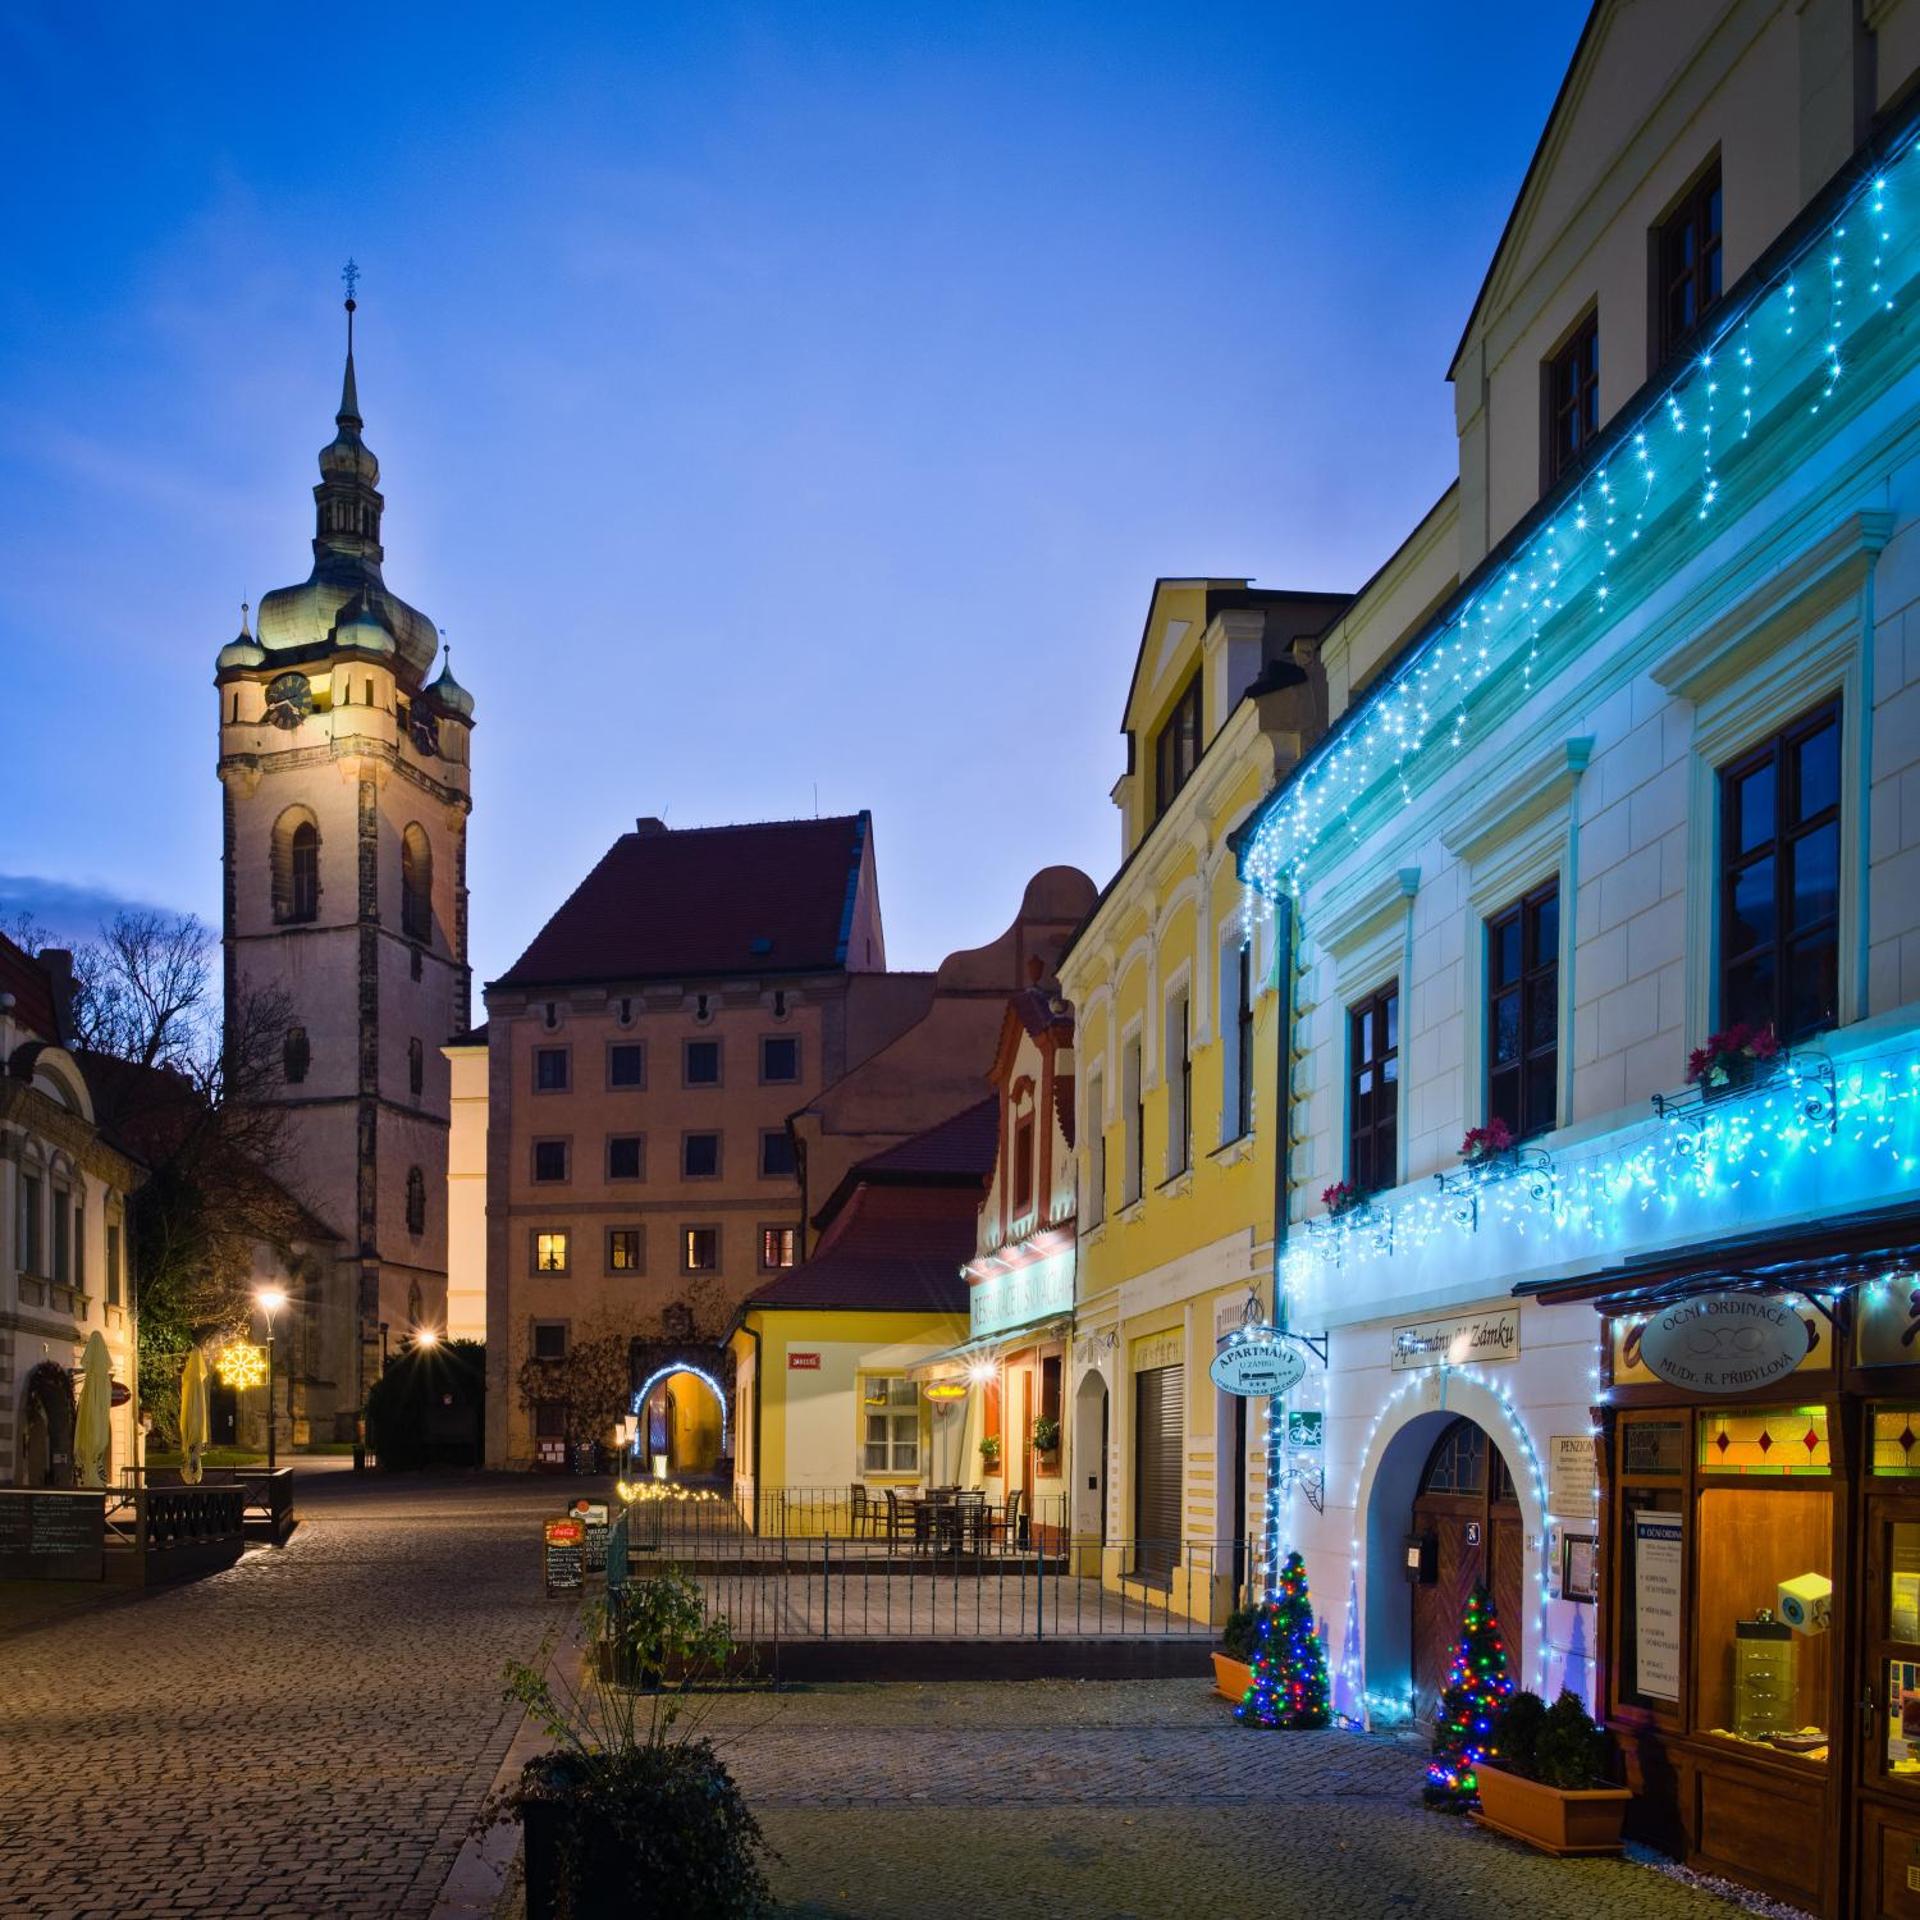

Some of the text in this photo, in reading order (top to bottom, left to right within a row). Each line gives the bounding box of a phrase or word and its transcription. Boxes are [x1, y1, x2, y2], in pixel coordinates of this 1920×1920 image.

[1662, 1300, 1787, 1331] OČNÍ ORDINACE
[1470, 1317, 1514, 1349] Zámku
[1659, 1356, 1699, 1384] MUDr.
[1721, 1351, 1794, 1385] PŘIBYLOVÁ
